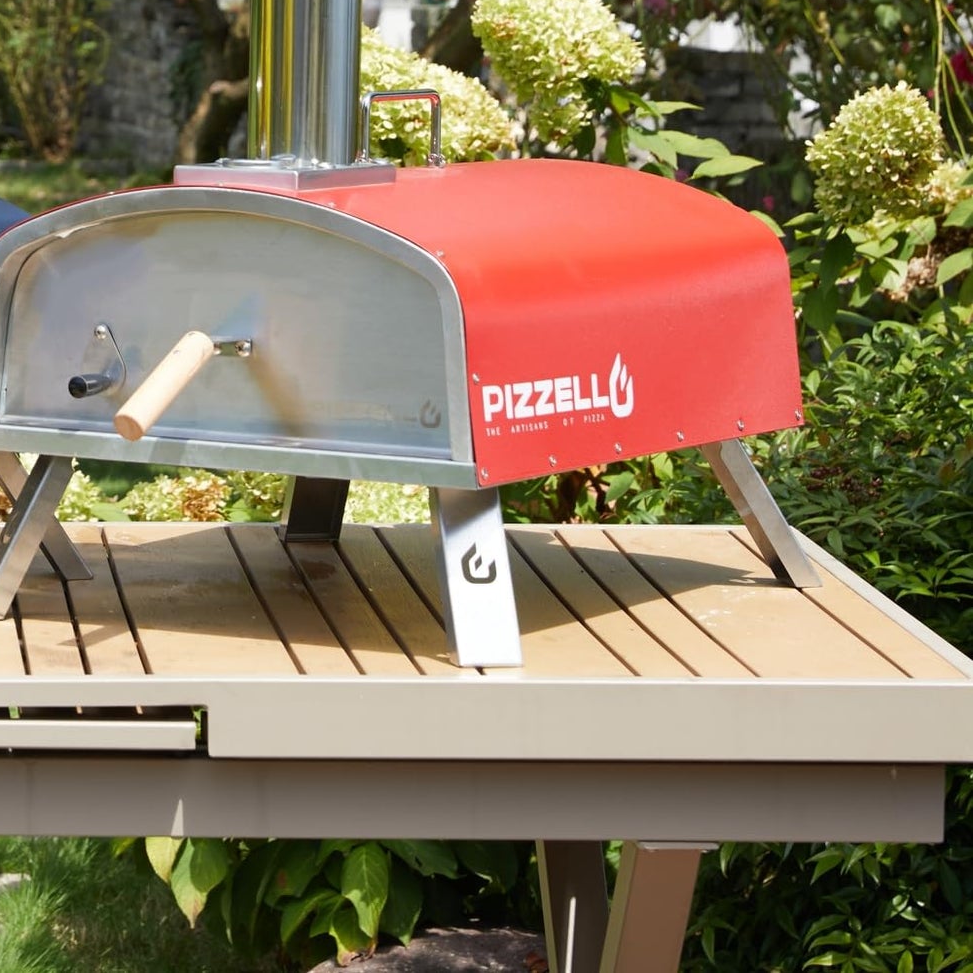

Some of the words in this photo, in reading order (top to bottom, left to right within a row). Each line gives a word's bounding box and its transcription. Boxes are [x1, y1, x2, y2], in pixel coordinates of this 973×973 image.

[485, 426, 501, 437] THE
[510, 420, 549, 434] ARTISANS
[583, 413, 606, 424] PIZZA
